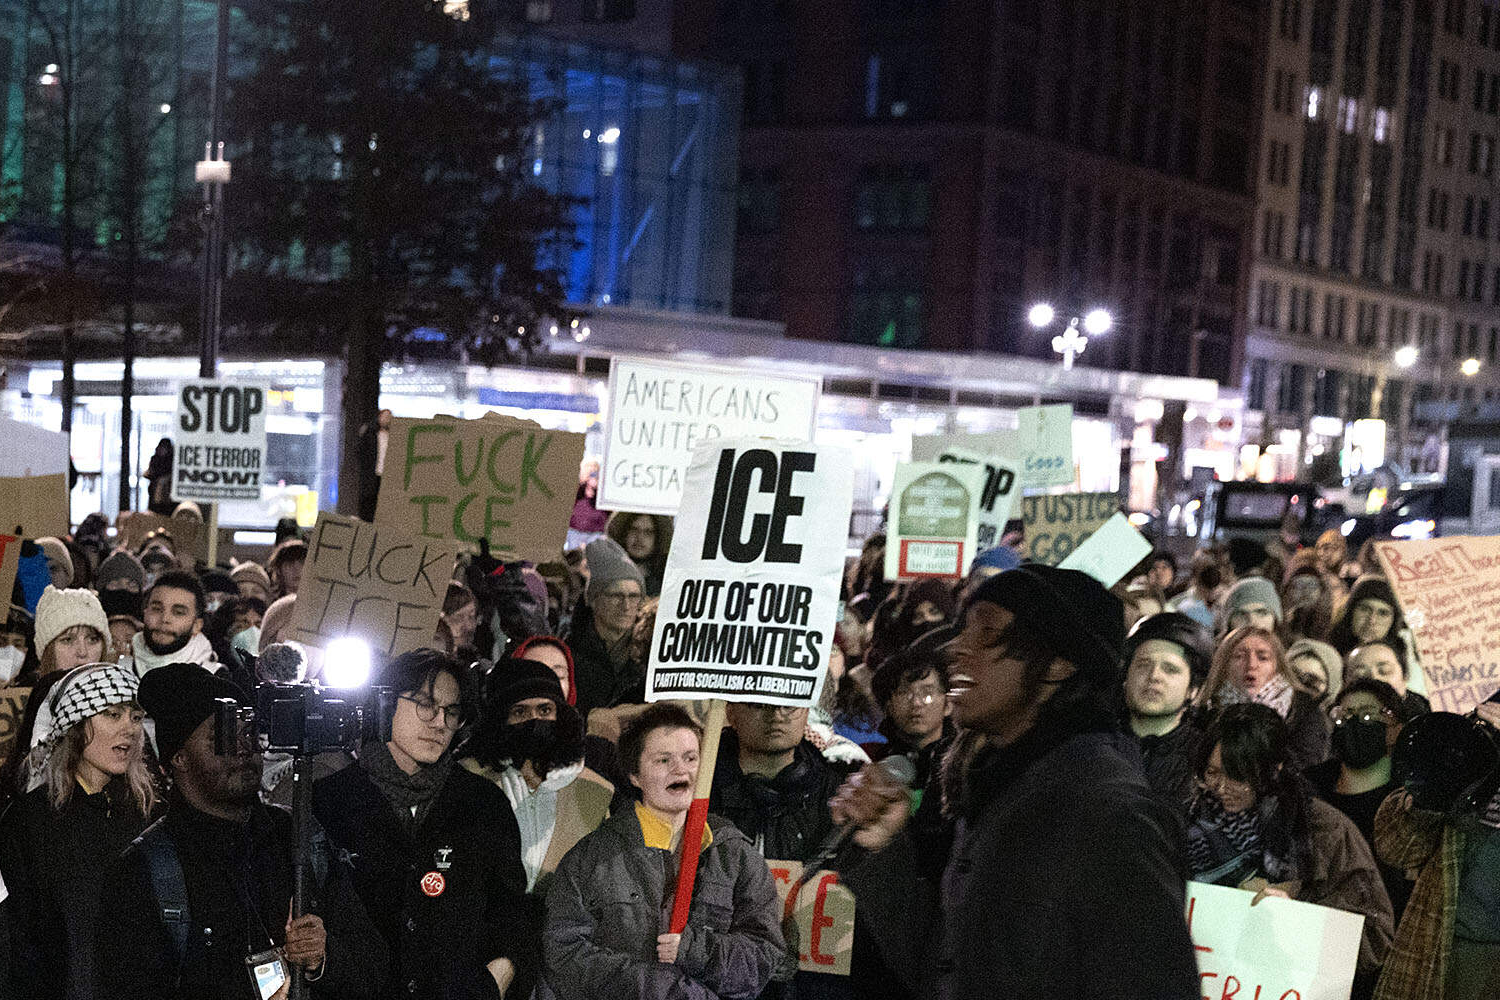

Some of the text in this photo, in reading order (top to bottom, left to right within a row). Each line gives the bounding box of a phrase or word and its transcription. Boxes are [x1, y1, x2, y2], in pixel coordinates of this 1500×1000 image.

[180, 385, 263, 433] STOP
[621, 371, 780, 423] AMERICANS
[179, 445, 260, 469] ICE TERROR
[618, 418, 722, 448] UNITED
[178, 469, 260, 485] NOW!
[403, 424, 554, 499] FUCK
[611, 457, 682, 493] GESTA
[410, 492, 516, 551] ICE
[702, 448, 817, 564] ICE
[313, 519, 448, 598] FUCK
[676, 579, 813, 627] OUT OF OUR
[658, 622, 824, 671] COMMUNITIES
[654, 671, 679, 689] PARTY
[677, 673, 697, 688] FOR
[695, 674, 744, 691] SOCIALISM
[756, 677, 813, 696] LIBERATION
